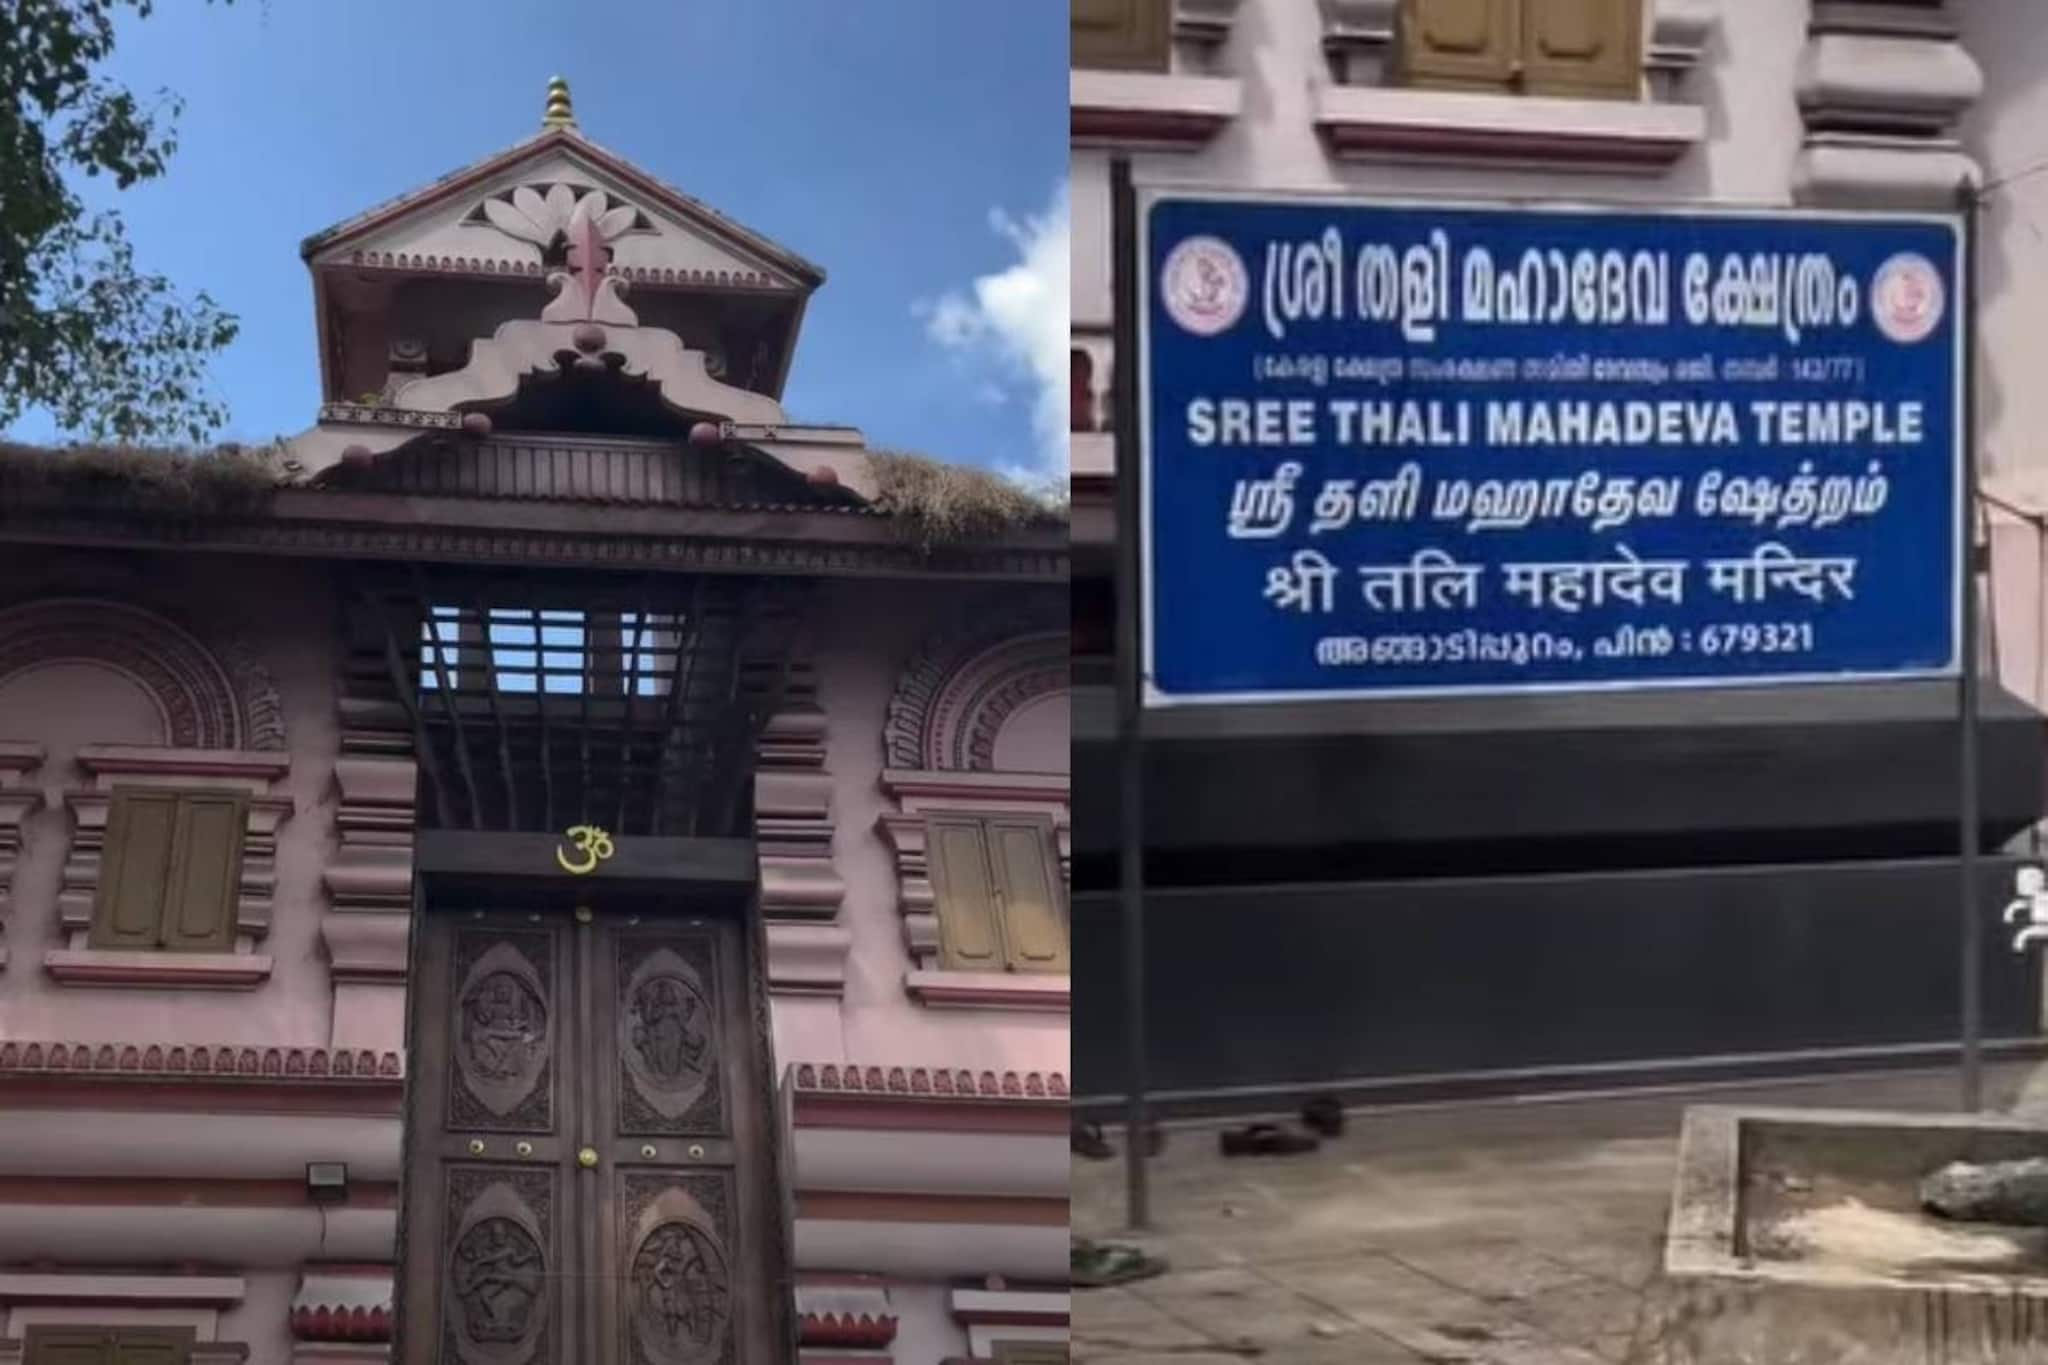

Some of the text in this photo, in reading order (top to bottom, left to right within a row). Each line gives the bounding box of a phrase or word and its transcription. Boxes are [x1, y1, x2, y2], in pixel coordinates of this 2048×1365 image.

[1264, 226, 1859, 345] ശ്രീ തളി മഹാദേവ ക്ഷേത്രം
[1186, 398, 1924, 446] SREE THALI MAHADEVA TEMPLE
[1309, 461, 1422, 534] தளி
[1432, 469, 1681, 534] மஹாதேவ
[1263, 541, 1858, 614] श्री तलि महादेव मन्दिर
[1700, 621, 1813, 655] 679321
